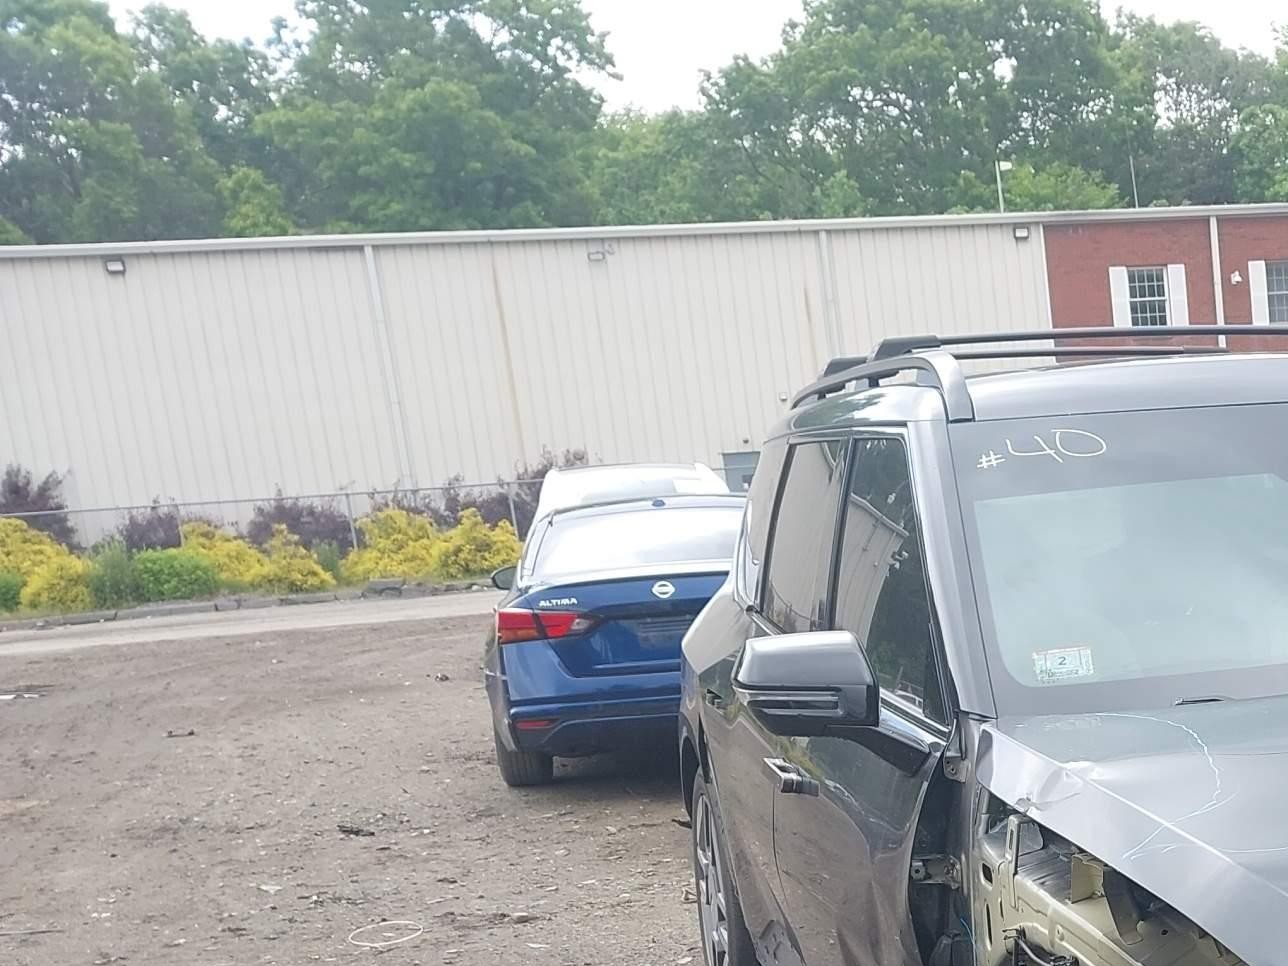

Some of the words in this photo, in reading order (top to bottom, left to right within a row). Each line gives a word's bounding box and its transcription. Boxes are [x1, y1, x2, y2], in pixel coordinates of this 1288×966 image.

[976, 428, 1107, 469] #40
[538, 597, 579, 607] ALTIMA
[1057, 655, 1068, 666] 2
